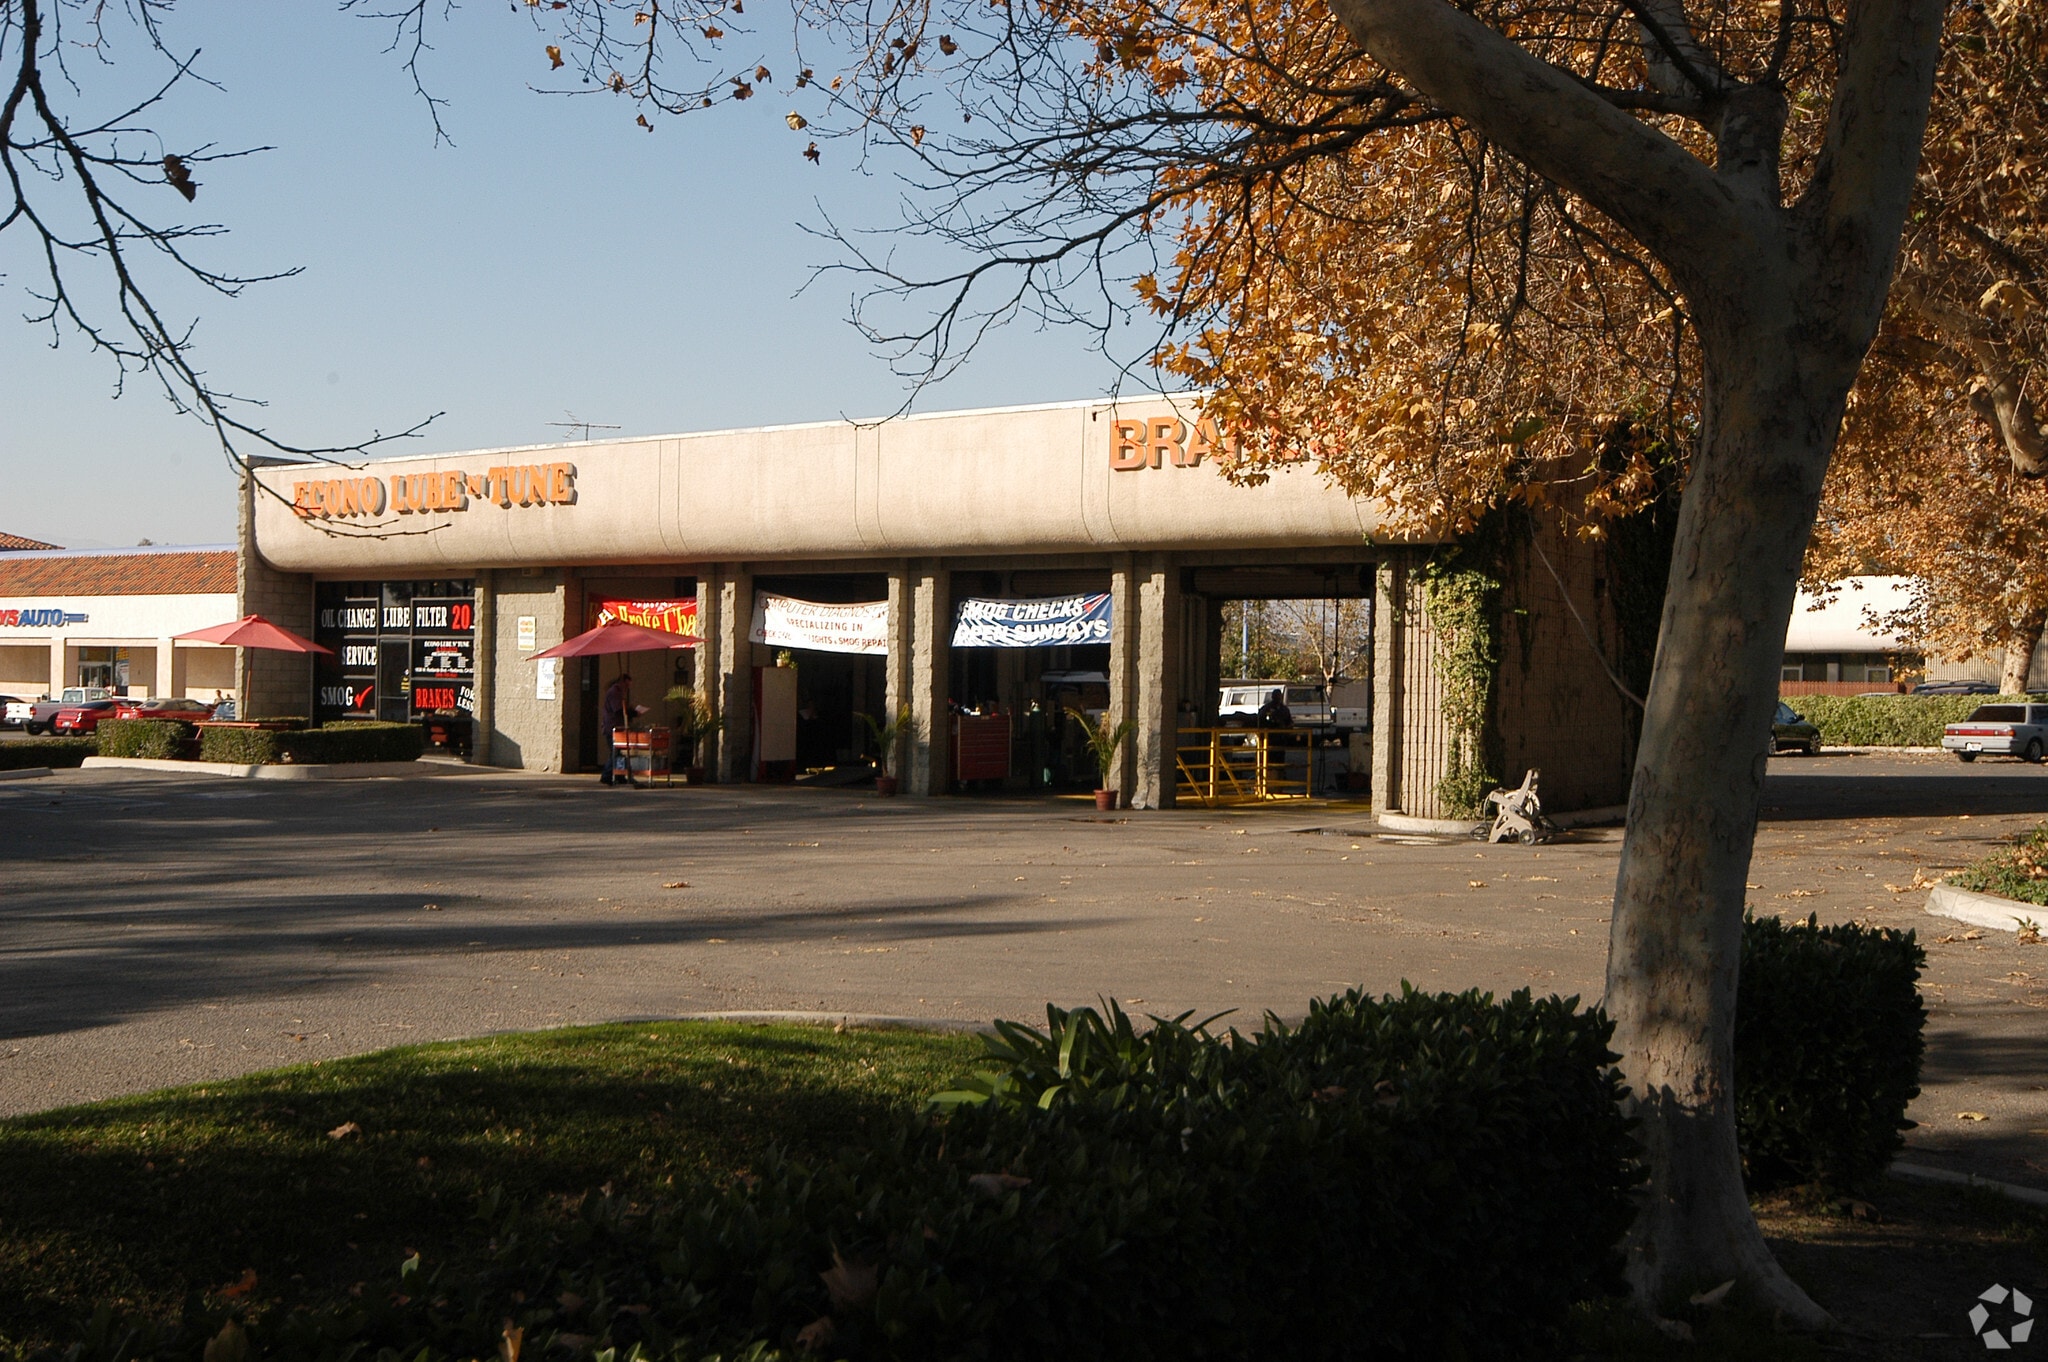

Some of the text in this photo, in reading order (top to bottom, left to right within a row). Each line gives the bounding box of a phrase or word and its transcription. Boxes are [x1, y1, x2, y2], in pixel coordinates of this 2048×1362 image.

[293, 476, 384, 518] ECONO
[390, 471, 467, 514] LUBE
[488, 462, 576, 511] TUNE
[18, 609, 64, 627] AUTO
[321, 604, 470, 630] OIL CHANGE LUBE FILTER 20
[1012, 598, 1085, 620] CHECKS
[786, 618, 863, 632] SPECIALIZING IN
[1013, 619, 1110, 642] SUNDAYS
[838, 637, 860, 647] SMOG
[342, 646, 377, 666] SERVICE
[321, 686, 353, 706] SMOG
[415, 688, 455, 709] BRAKES
[460, 685, 475, 701] FOR
[457, 696, 474, 711] LESS
